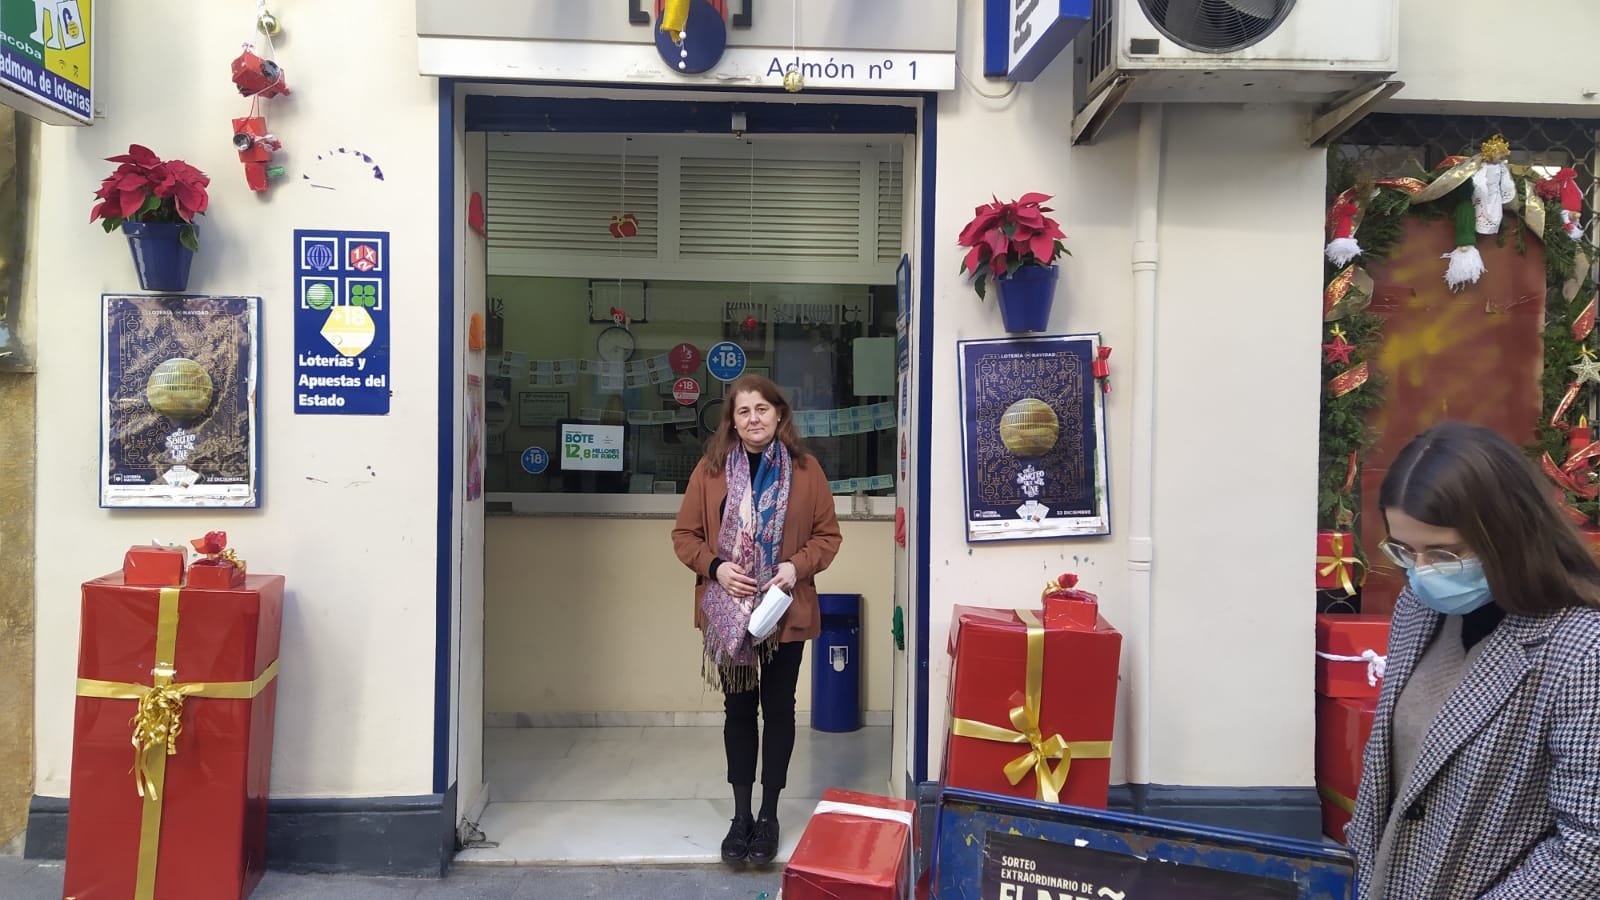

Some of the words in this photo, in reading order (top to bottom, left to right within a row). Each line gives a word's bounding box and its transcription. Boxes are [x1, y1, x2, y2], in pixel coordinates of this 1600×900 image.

[766, 56, 854, 79] Admón
[909, 61, 917, 80] 1
[39, 71, 51, 94] de
[299, 354, 354, 367] Loterías
[357, 357, 366, 370] y
[711, 351, 737, 367] +18
[298, 374, 361, 389] Apuestas
[365, 374, 386, 388] del
[677, 381, 693, 390] +18
[299, 394, 346, 407] Estado
[565, 433, 594, 444] BOTE
[524, 453, 542, 465] +18
[1001, 855, 1036, 871] SORTEO
[1001, 869, 1079, 892] EXTRAORDINARIO
[1081, 883, 1093, 895] DE
